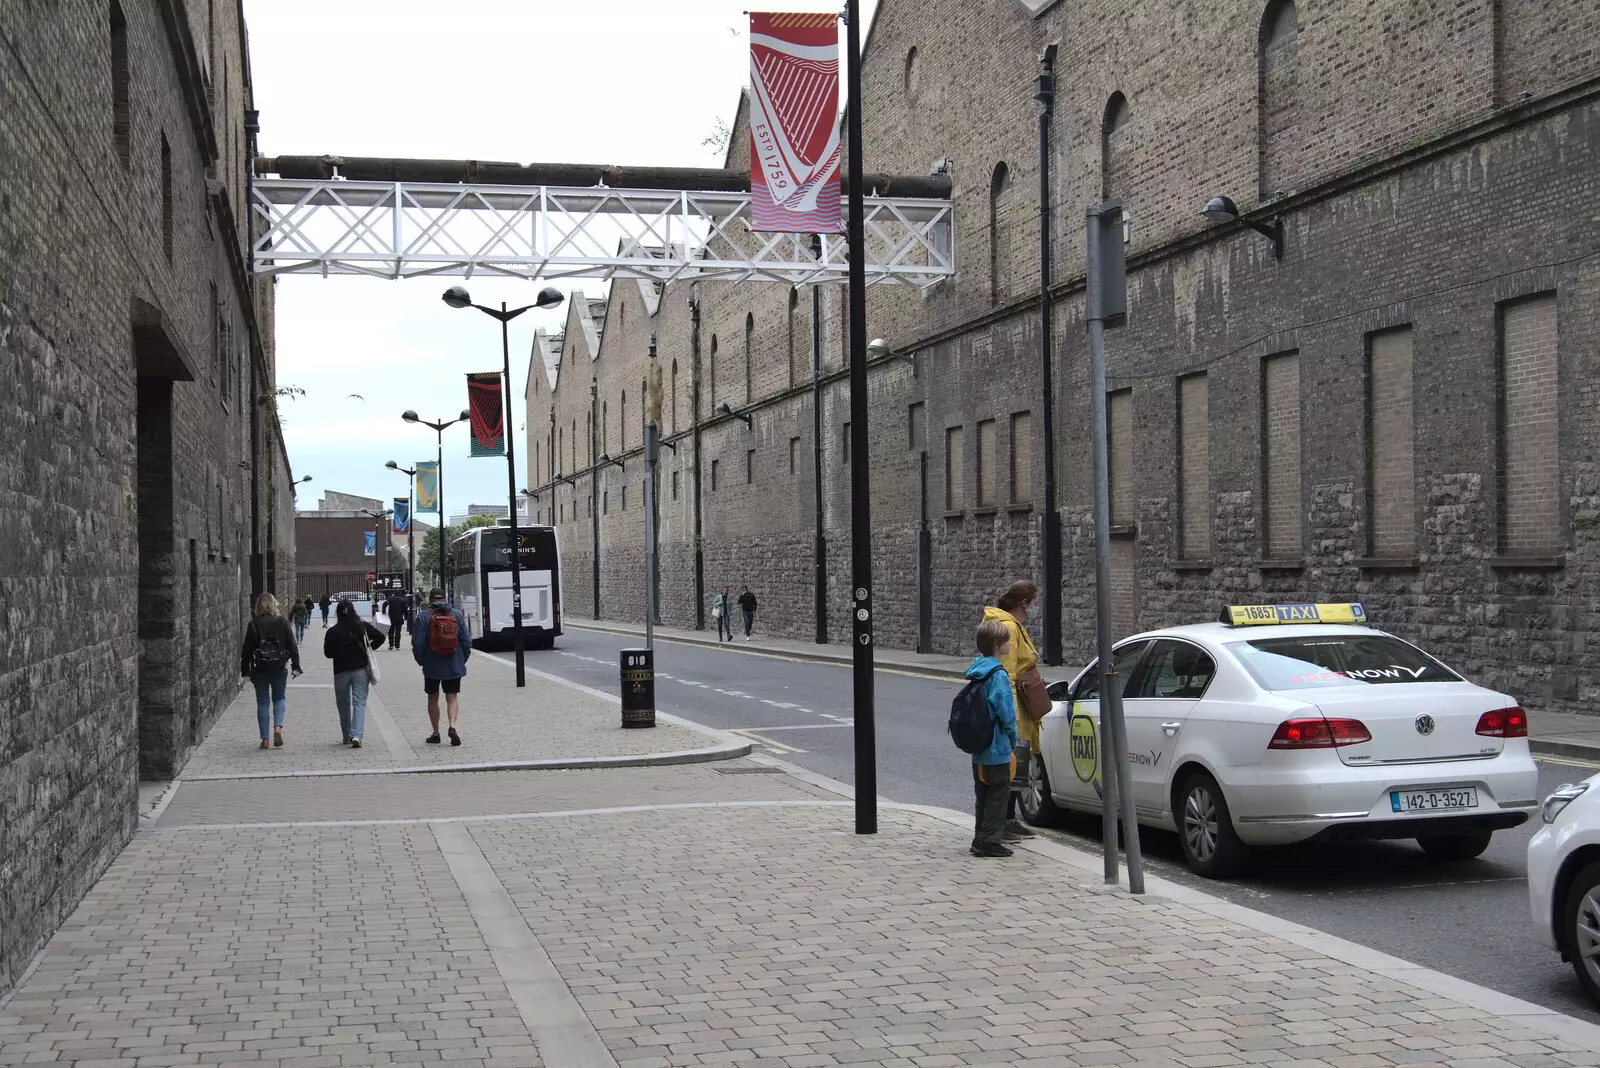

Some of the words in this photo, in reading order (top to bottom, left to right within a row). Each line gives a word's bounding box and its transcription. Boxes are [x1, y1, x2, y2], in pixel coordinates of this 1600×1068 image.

[764, 154, 787, 189] 1759
[1244, 606, 1276, 620] 16857
[1278, 606, 1318, 620] TAXI
[1072, 735, 1094, 760] TAXI
[1406, 791, 1471, 809] 142-D-3527
